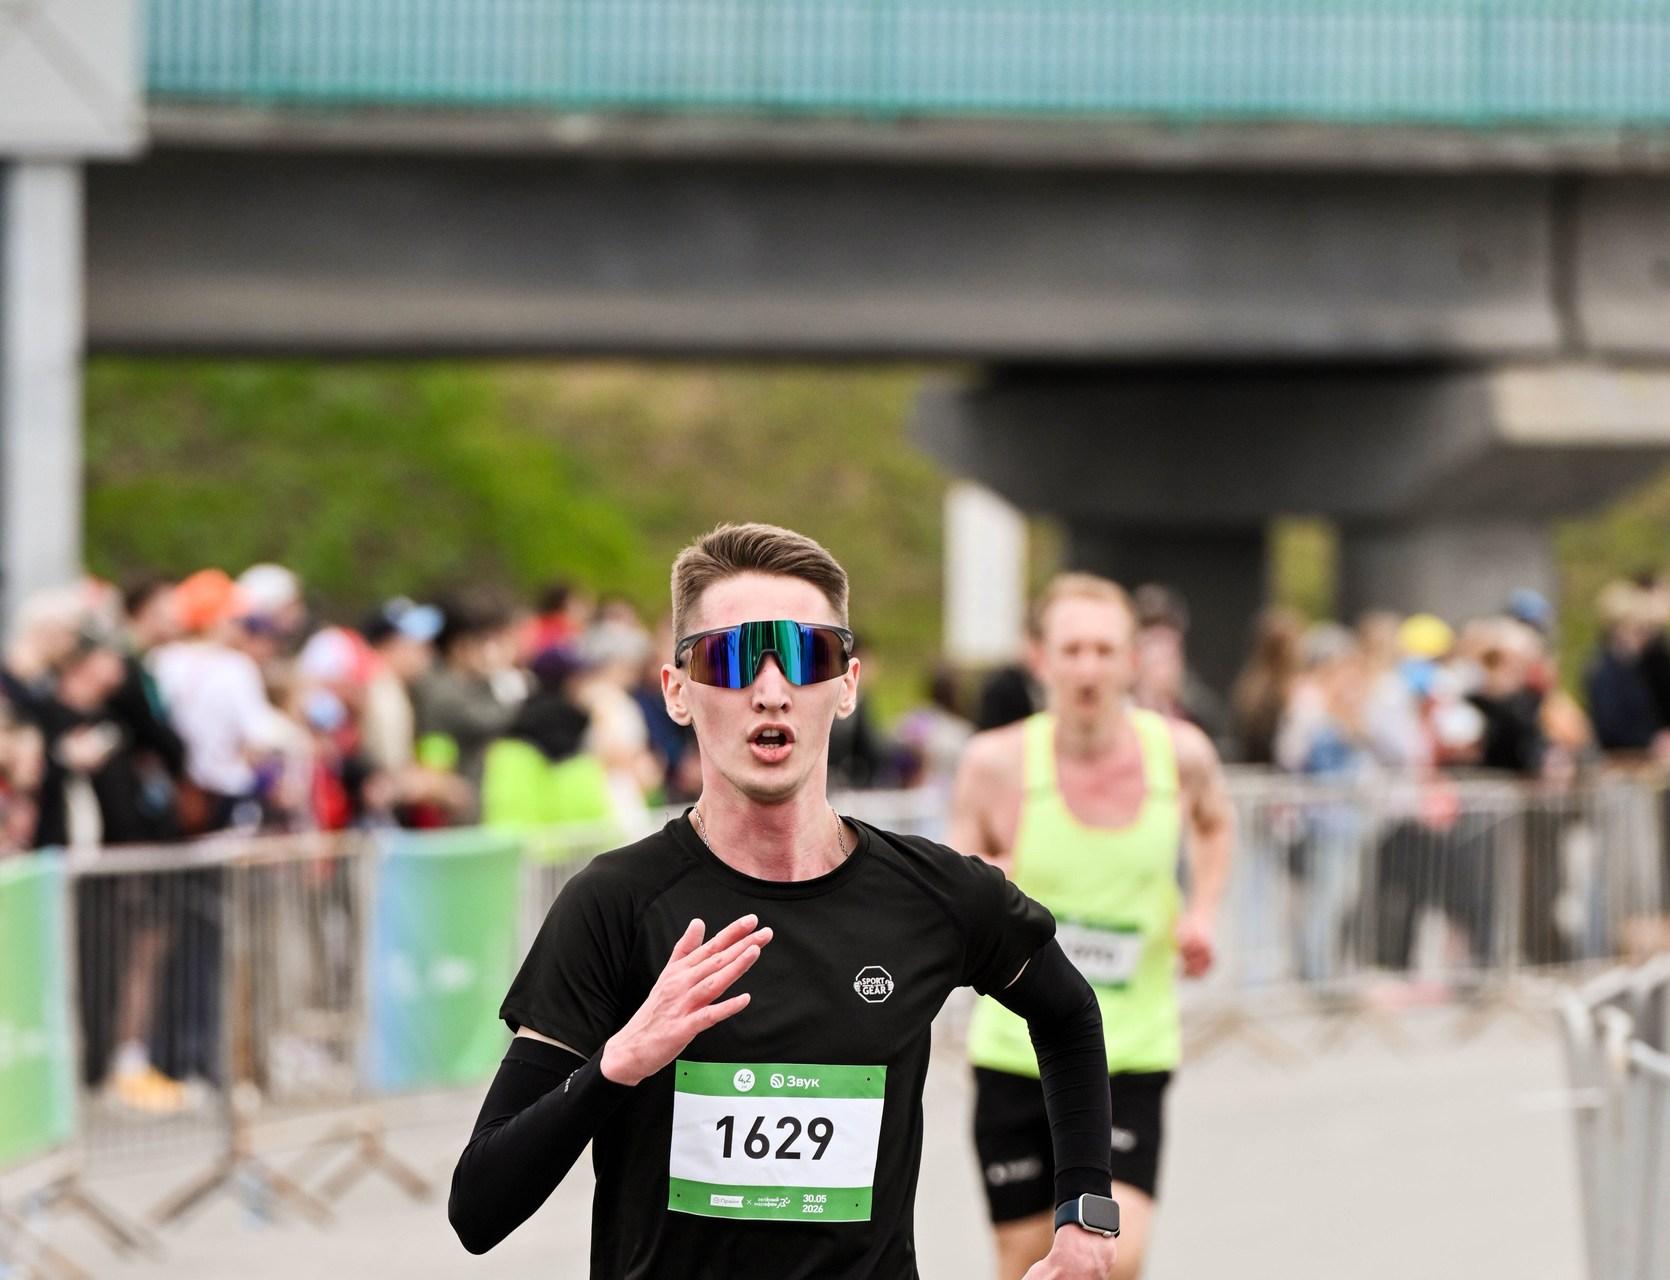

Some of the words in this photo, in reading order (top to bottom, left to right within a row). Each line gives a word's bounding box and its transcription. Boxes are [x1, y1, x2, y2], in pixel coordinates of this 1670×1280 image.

[862, 977, 885, 985] SPORT
[862, 985, 887, 995] GEAR
[738, 1074, 752, 1084] 4,2
[786, 1075, 820, 1090] Звук
[716, 1115, 834, 1161] 1629
[802, 1194, 827, 1203] 30.05
[802, 1204, 824, 1213] 2026
